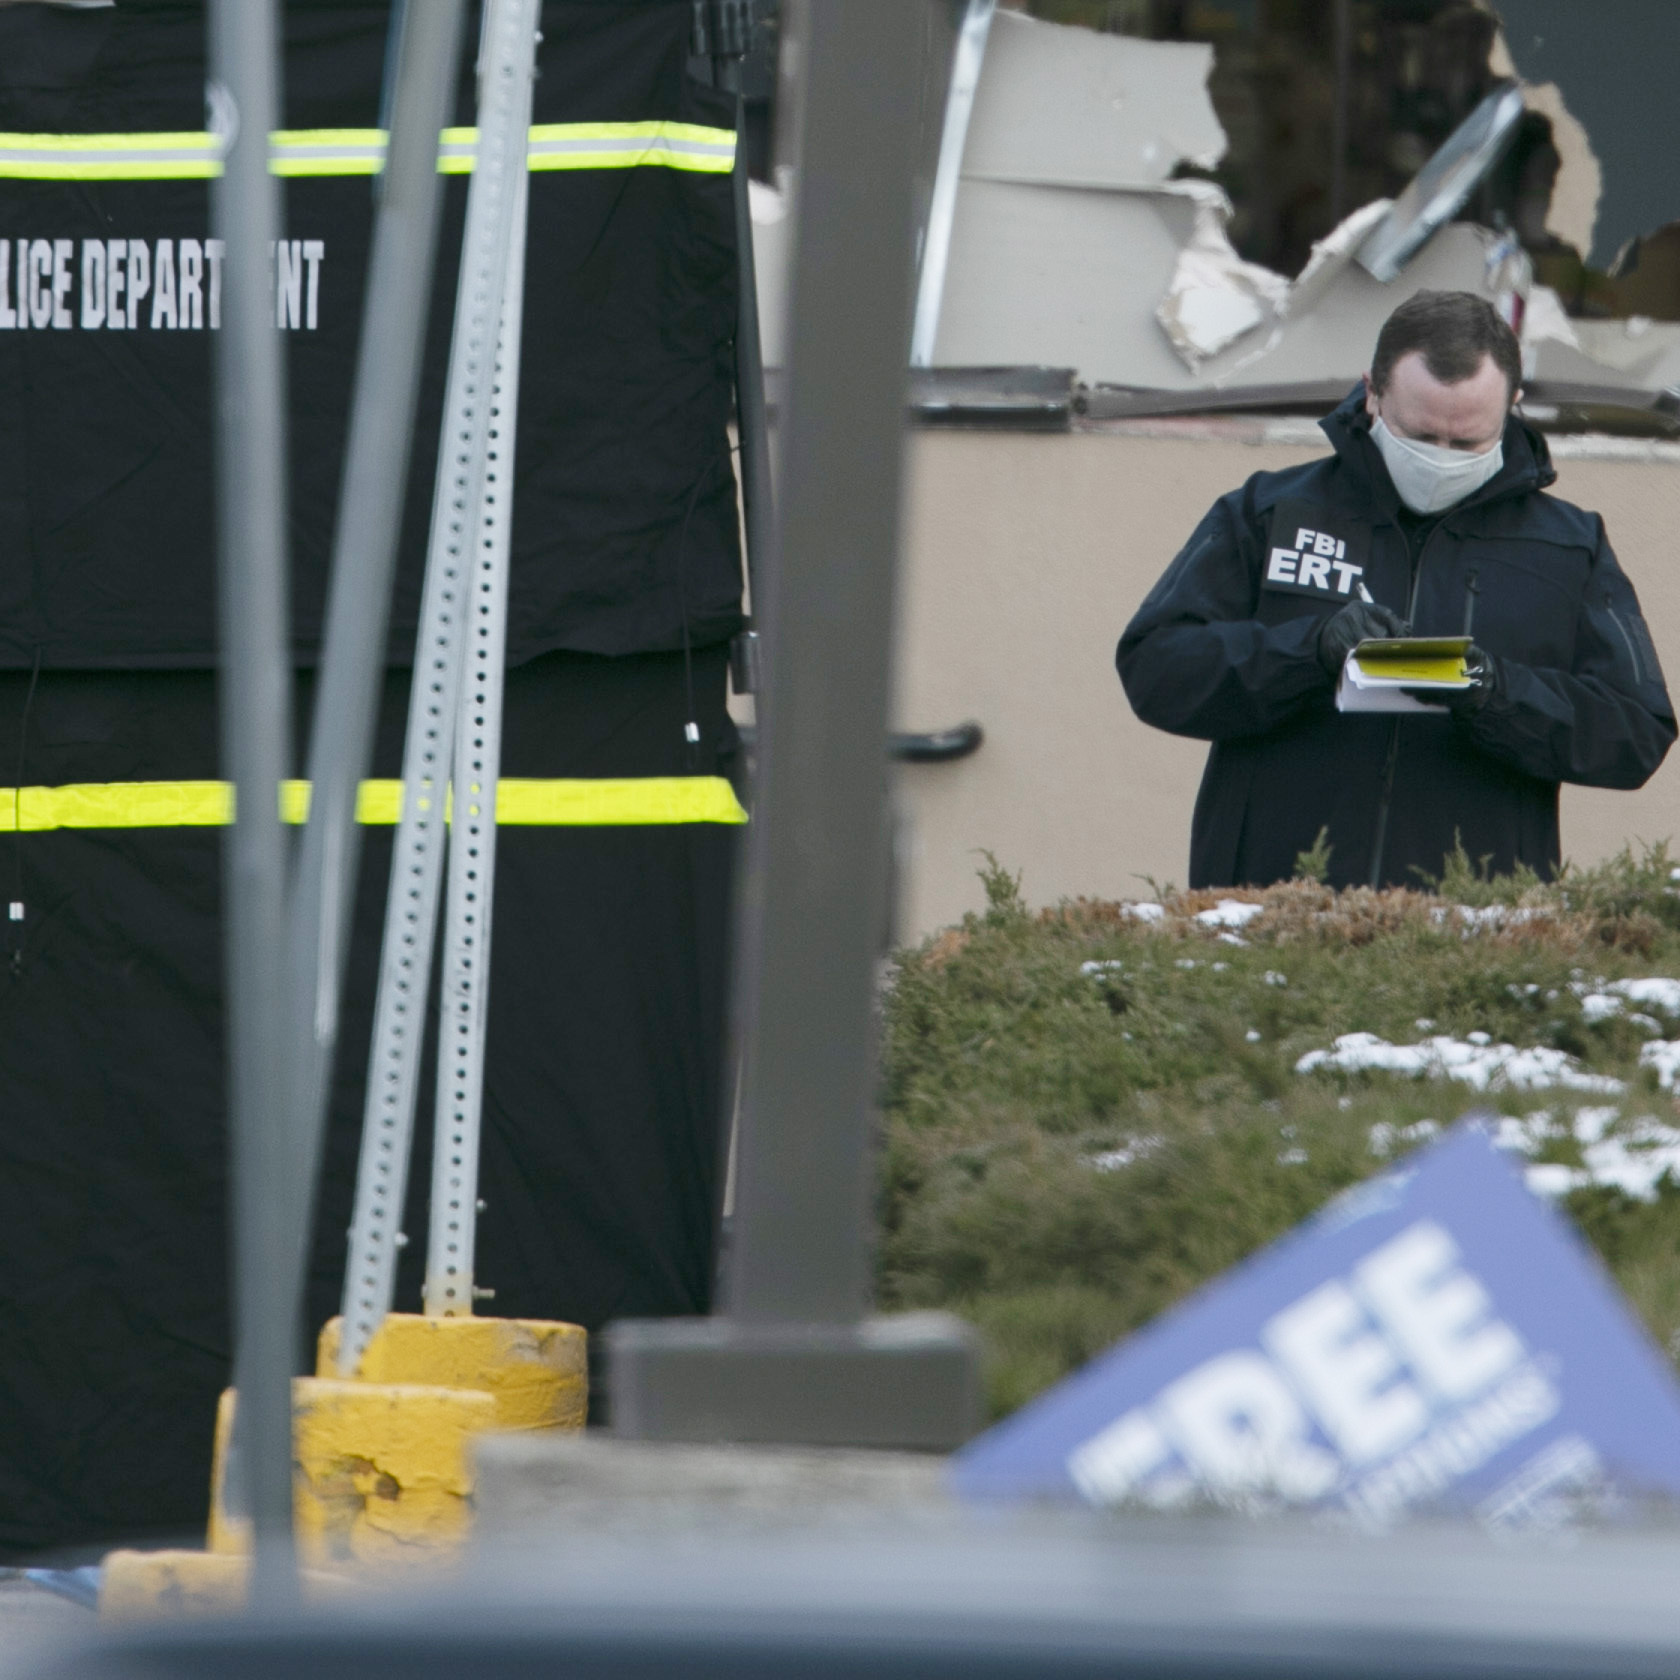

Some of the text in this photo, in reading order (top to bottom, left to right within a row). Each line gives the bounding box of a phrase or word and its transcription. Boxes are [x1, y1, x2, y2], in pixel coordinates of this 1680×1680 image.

[81, 238, 325, 330] DEPARTNT
[1267, 547, 1363, 595] ERT
[1295, 527, 1346, 560] FBI
[1065, 1219, 1528, 1506] FREE
